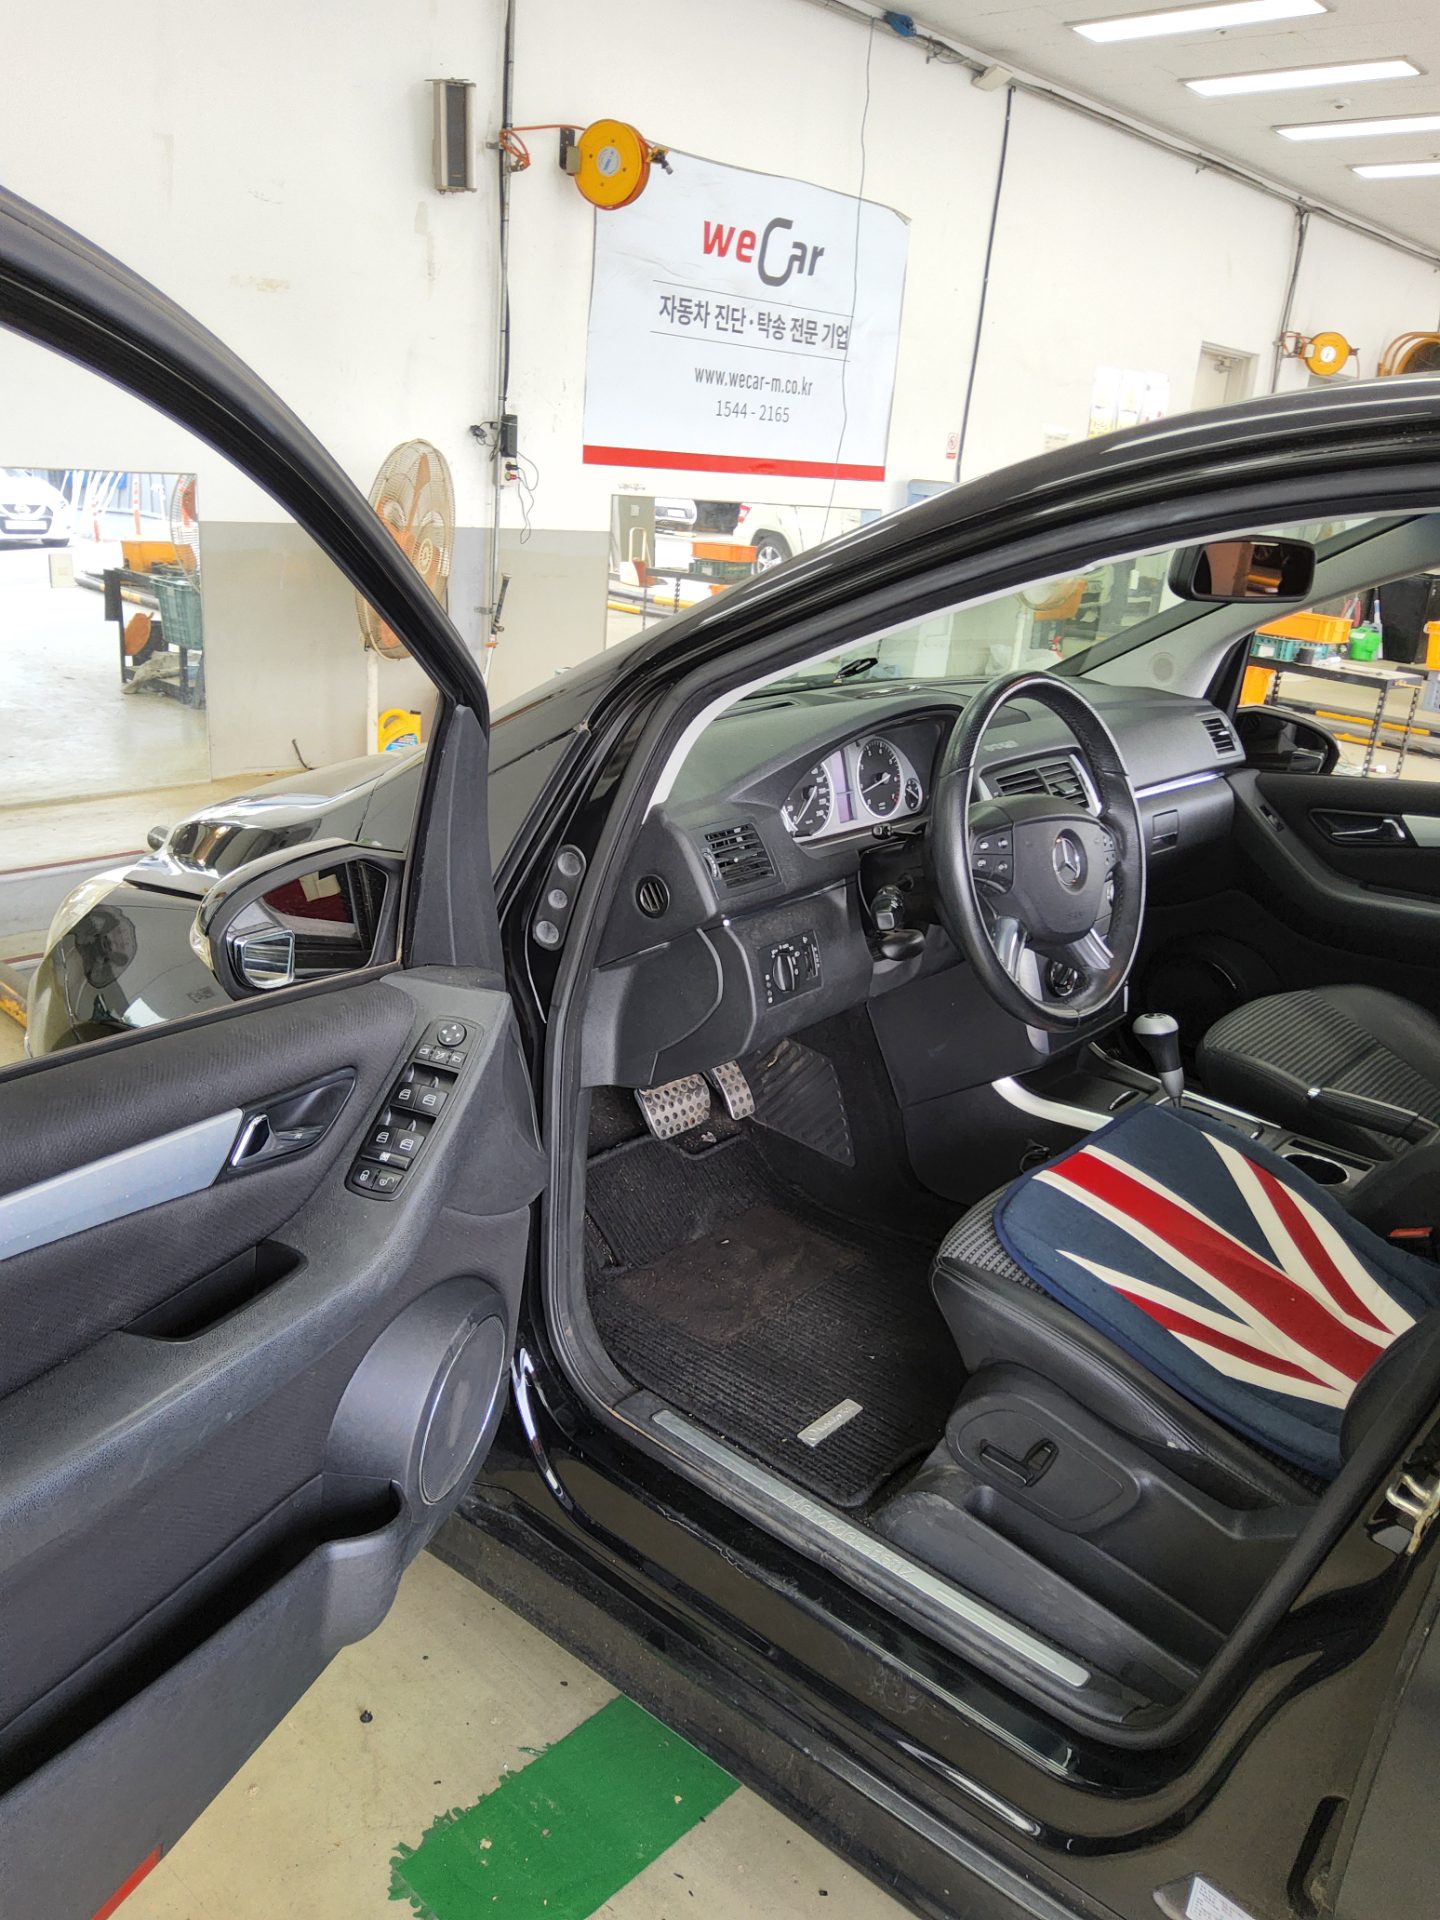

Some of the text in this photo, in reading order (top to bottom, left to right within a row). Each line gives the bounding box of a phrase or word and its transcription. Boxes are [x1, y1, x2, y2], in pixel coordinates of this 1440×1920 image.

[659, 294, 711, 329] 자동차
[790, 316, 819, 346] 전문
[821, 321, 849, 351] 기업
[694, 367, 813, 396] www.wecar-m.co.kr
